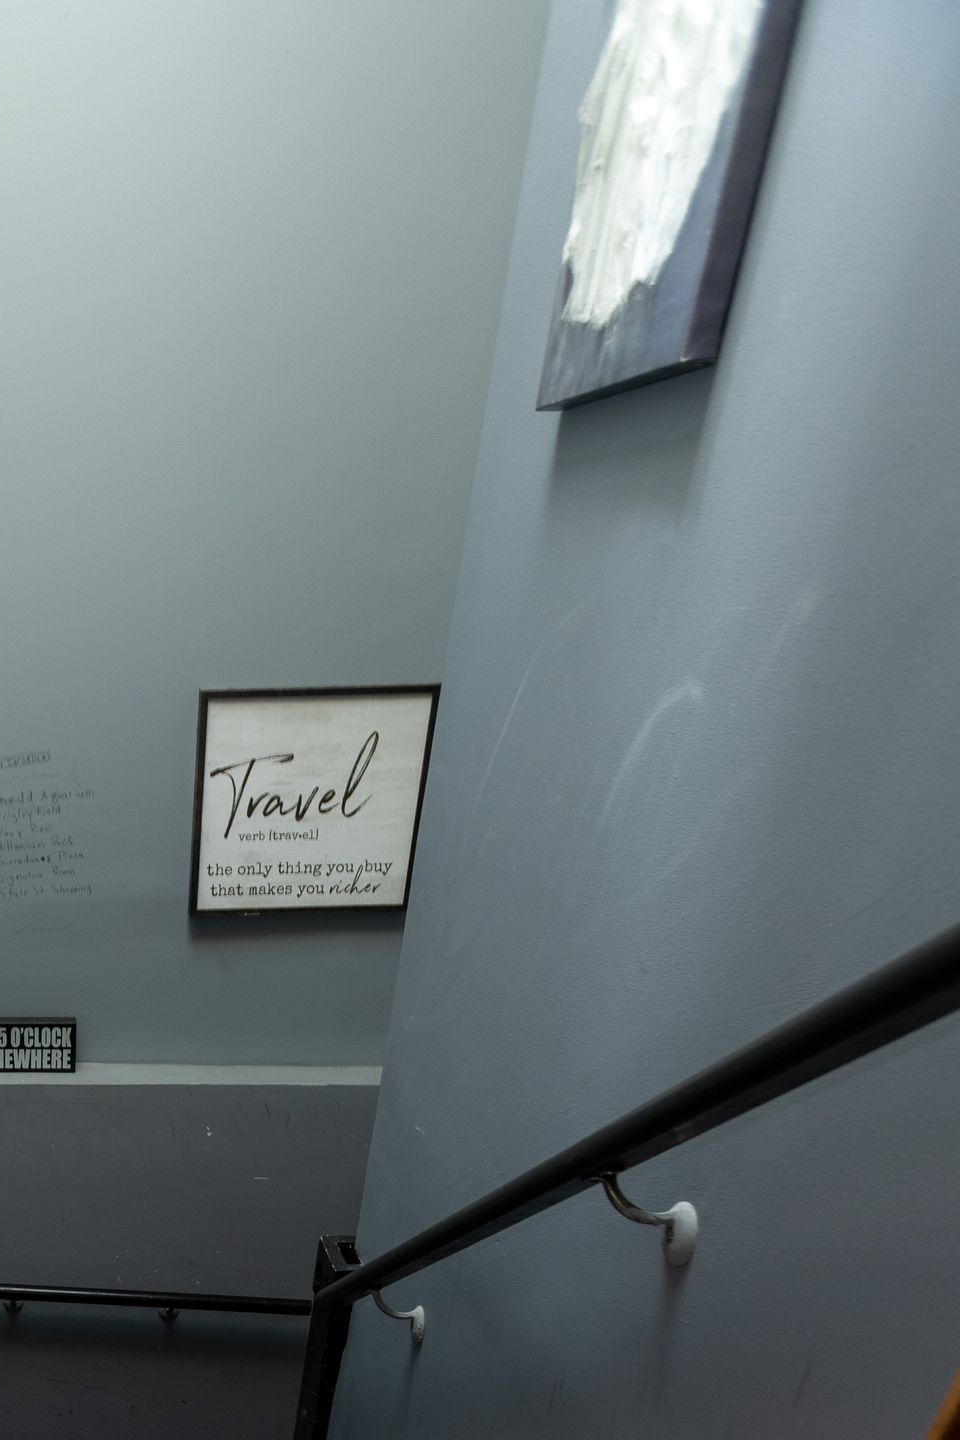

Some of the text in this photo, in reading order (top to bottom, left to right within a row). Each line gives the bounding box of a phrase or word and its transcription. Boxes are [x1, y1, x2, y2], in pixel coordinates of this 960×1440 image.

[209, 730, 380, 839] Travel
[40, 790, 95, 803] Aquarium
[238, 830, 266, 842] verb
[206, 859, 393, 877] the only thing you buy
[210, 864, 382, 898] that makes you richer
[10, 1026, 72, 1048] O'CLOCK
